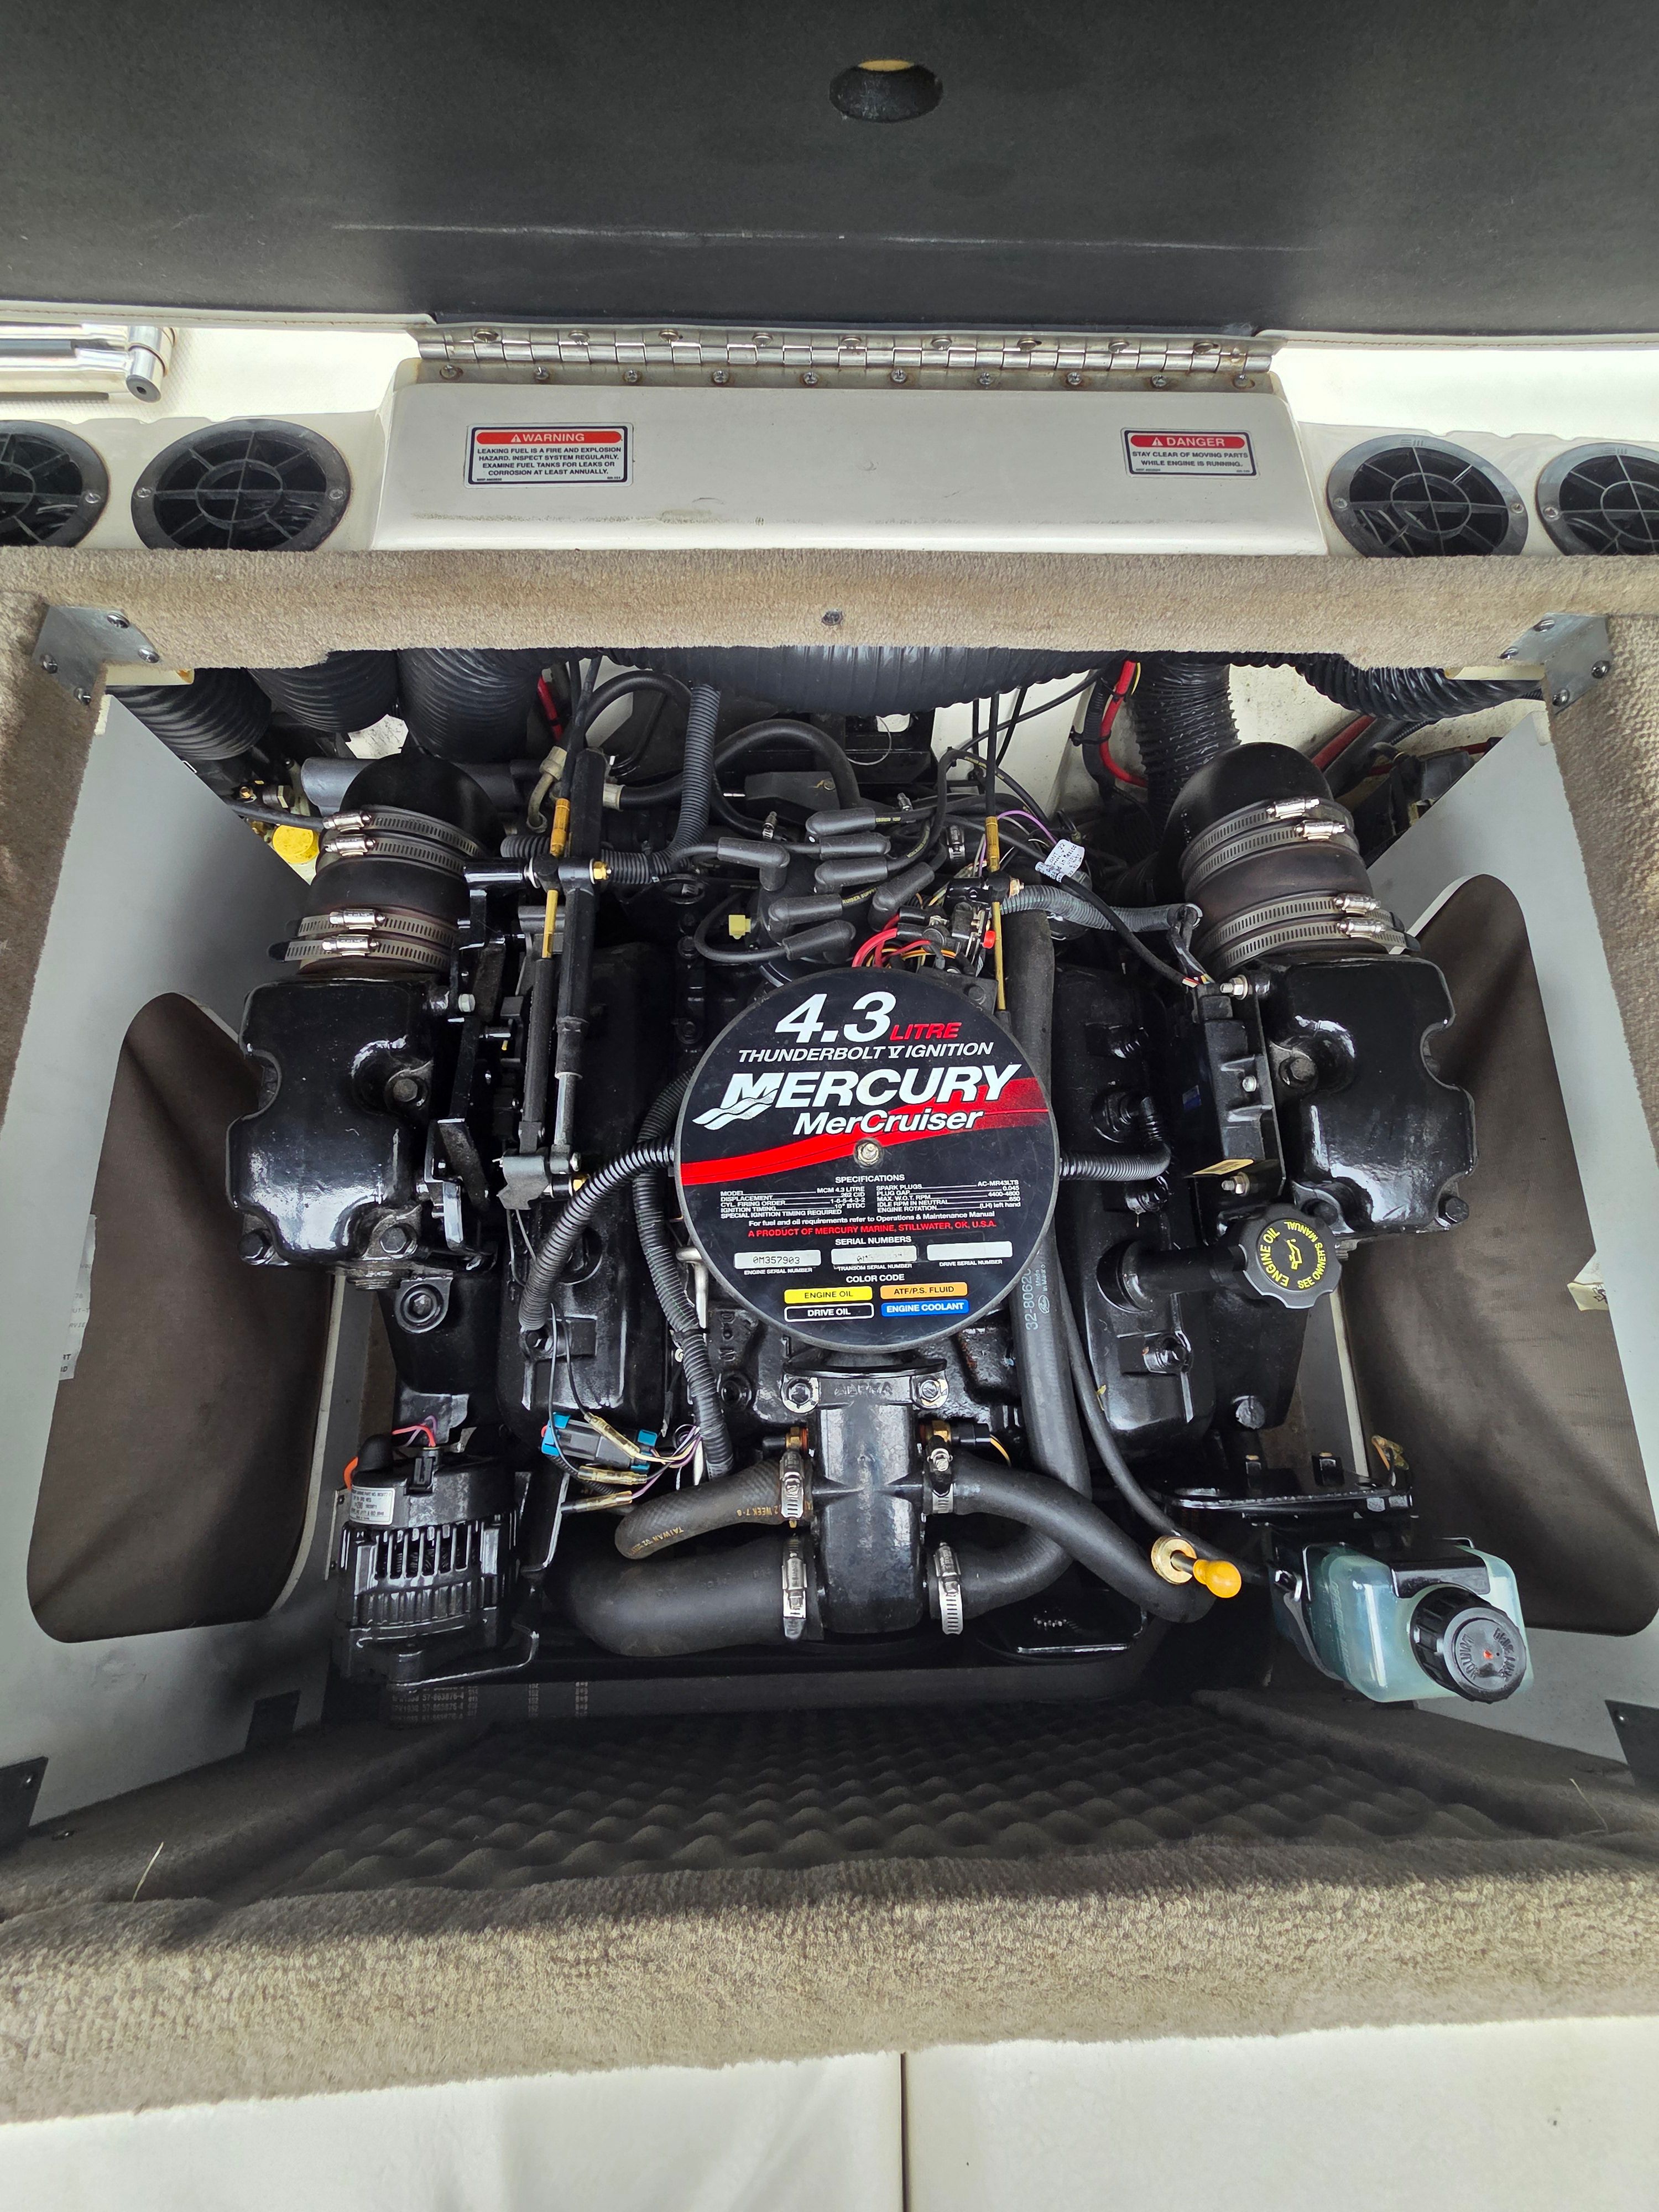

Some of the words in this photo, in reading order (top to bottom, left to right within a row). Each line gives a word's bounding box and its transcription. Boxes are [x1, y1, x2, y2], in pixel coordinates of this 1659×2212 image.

[523, 433, 585, 442] WARNING
[1166, 437, 1225, 447] DANGER
[775, 991, 897, 1044] 4.3
[890, 1022, 962, 1041] LITRE
[739, 1045, 883, 1063] THUNDERBOLT
[905, 1042, 994, 1058] IGNITION
[720, 1063, 1022, 1108] MERCURY
[793, 1109, 984, 1136] MerCruiser
[835, 1174, 905, 1183] SPECIFICATIONS
[876, 1214, 915, 1223] Operations
[756, 1228, 799, 1237] PRODUCT
[815, 1226, 859, 1234] MERCURY
[860, 1224, 897, 1233] MARINE,
[898, 1222, 953, 1232] STILLWATER,
[1262, 1228, 1280, 1244] OIL
[1284, 1221, 1318, 1243] MANUAL
[868, 1236, 912, 1244] NUMBERS
[1260, 1244, 1290, 1287] ENGINE
[1312, 1242, 1327, 1281] OWNER'S
[1297, 1276, 1316, 1289] SEE
[886, 1304, 920, 1313] ENGINE
[921, 1302, 964, 1311] COOLANT
[753, 1506, 773, 1516] WEEK
[652, 1526, 684, 1542] TAIWAN
